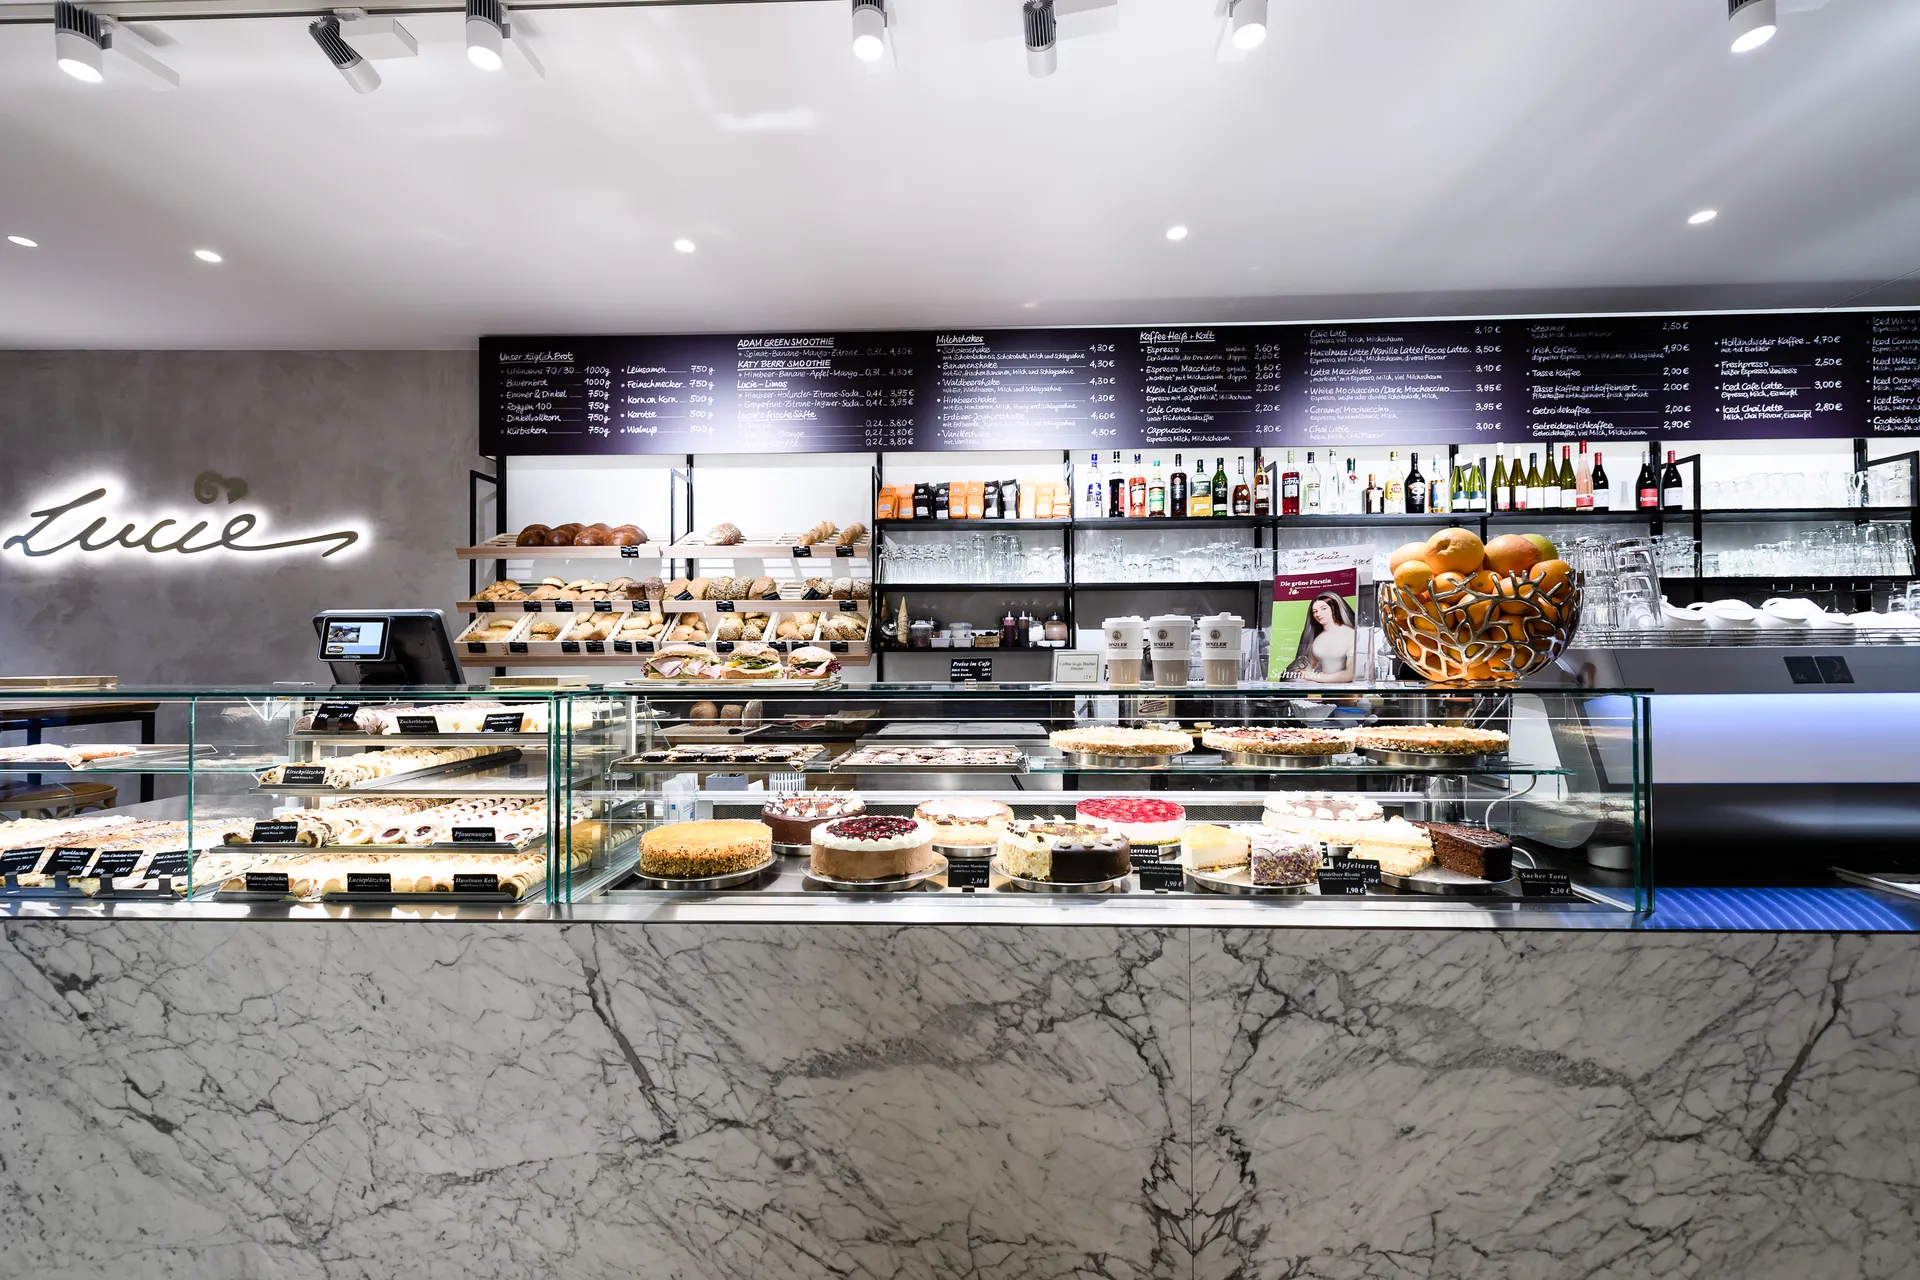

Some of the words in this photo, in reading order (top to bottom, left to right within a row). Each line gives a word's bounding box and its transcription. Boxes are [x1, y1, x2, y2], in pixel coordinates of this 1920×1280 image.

[737, 339, 762, 347] ADAM
[763, 338, 791, 347] GREEN
[791, 337, 835, 346] SMOOTHIE
[935, 335, 985, 345] Milchshakes
[1139, 331, 1166, 344] Kaffee
[1167, 331, 1188, 343] Heiß
[1195, 331, 1215, 340] Kalt
[1721, 336, 1776, 347] Holländischer
[1777, 336, 1805, 347] Kaffee
[1872, 337, 1891, 346] Iced
[941, 346, 991, 354] Schokoshake
[1146, 346, 1180, 356] Espresso
[1310, 348, 1348, 357] Haselnuss
[1531, 346, 1552, 354] Irish
[1553, 346, 1578, 355] Coffee
[499, 352, 522, 361] Unser
[524, 351, 552, 363] täglich
[554, 352, 574, 360] Brot
[1873, 356, 1891, 365] Iced
[1891, 356, 1918, 365] White
[737, 360, 759, 368] KATY
[760, 360, 786, 368] BERRY
[786, 359, 831, 367] SMOOTHIE
[942, 361, 999, 370] Bananenshake
[1721, 360, 1769, 370] Freshpresso
[626, 365, 667, 375] Leinsamen
[1145, 365, 1179, 375] Espresso
[1181, 364, 1221, 372] Macchiato
[1310, 367, 1330, 376] Latte
[1331, 367, 1372, 375] Macchiato
[1531, 369, 1554, 377] Tasse
[1555, 368, 1582, 378] Kaffee
[505, 378, 549, 387] Bauernbrot
[626, 379, 683, 389] Feinschmecker
[941, 378, 1001, 386] Waldbeershake
[1873, 375, 1891, 385] Iced
[1145, 386, 1167, 394] Klein
[1167, 385, 1188, 393] Lucie
[1188, 383, 1219, 394] Spezial
[1310, 386, 1334, 395] White
[1404, 385, 1450, 393] Mochaccino
[1531, 385, 1554, 393] Tasse
[1554, 384, 1581, 394] Kaffee
[1722, 382, 1740, 391] Iced
[1761, 381, 1784, 390] Latte
[506, 391, 533, 399] Emmer
[534, 389, 541, 399] &
[541, 390, 568, 399] Dinkel
[658, 395, 678, 404] Korn
[1873, 395, 1892, 405] Iced
[1892, 395, 1915, 405] Berry
[507, 402, 534, 415] Roggen
[535, 402, 552, 410] 100
[1147, 405, 1165, 416] Cafe
[1165, 405, 1193, 413] Crema
[1309, 406, 1342, 414] Caramel
[1532, 406, 1592, 416] Getreidekaffee
[1722, 404, 1740, 414] Iced
[1741, 404, 1761, 413] Chai
[1761, 404, 1784, 413] Latte
[506, 413, 562, 422] Dinkelvollkorn
[627, 410, 658, 420] Karotte
[1873, 416, 1903, 425] Cookie
[506, 425, 548, 435] Kürbiskern
[1308, 424, 1328, 433] Chai
[1329, 424, 1350, 433] Latte
[1532, 421, 1615, 431] Getreidemilchkaffee
[1146, 427, 1192, 436] Cappuccino
[3, 487, 359, 558] Lucie
[1336, 862, 1378, 870] Apfeltarte
[348, 876, 390, 884] Lucieplätzchen
